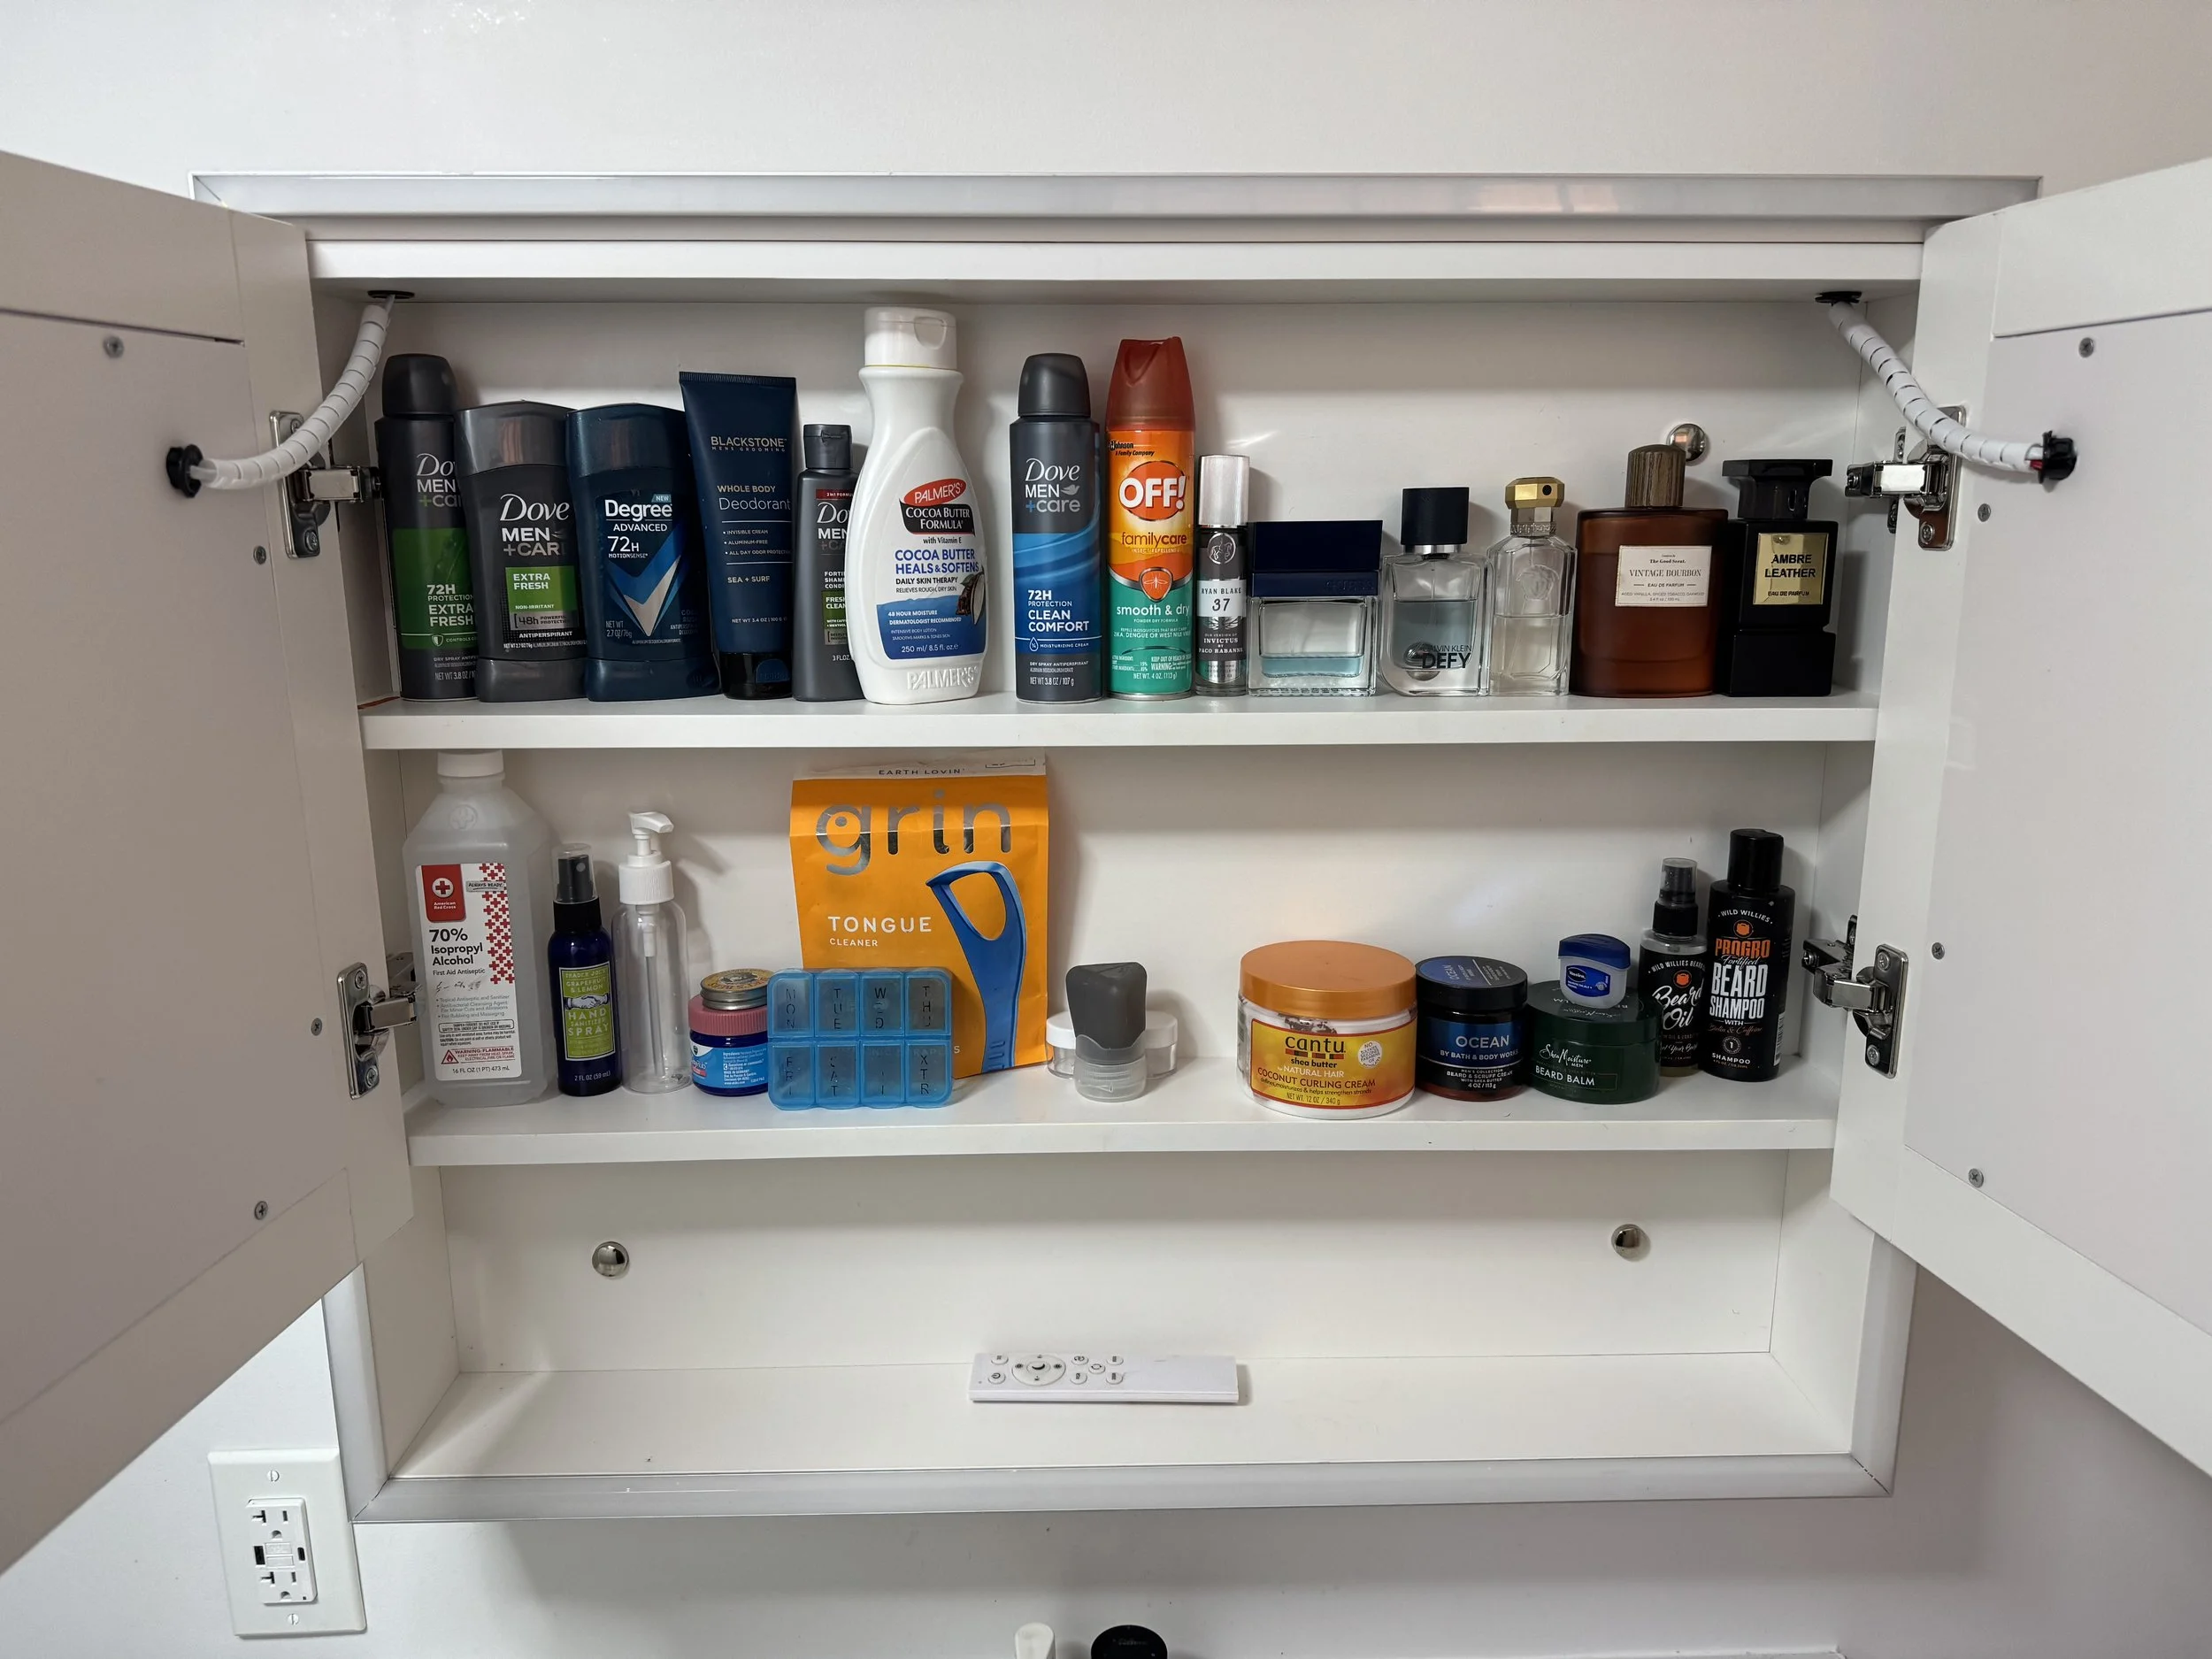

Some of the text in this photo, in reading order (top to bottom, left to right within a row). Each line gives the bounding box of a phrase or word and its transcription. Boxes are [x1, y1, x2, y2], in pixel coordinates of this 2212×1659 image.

[710, 435, 785, 448] BLACKSTONE
[416, 453, 456, 477] Do
[1025, 457, 1080, 481] Dove
[417, 479, 456, 494] MEN
[914, 481, 962, 504] PALMER'S
[1025, 484, 1060, 498] MEN
[1118, 475, 1187, 511] OFF!
[500, 493, 570, 521] Dove
[604, 499, 672, 522] Degree
[718, 497, 791, 511] Deodorant
[1025, 499, 1081, 512] +care
[817, 501, 850, 524] Do
[905, 507, 970, 518] COCOA BUTTER
[613, 523, 668, 532] ADVANCED
[920, 518, 962, 530] FORMULA
[502, 527, 550, 542] MEN
[818, 527, 848, 540] MEN
[1121, 532, 1187, 548] familycare
[503, 542, 564, 557] +CAR
[607, 535, 640, 552] 72H
[895, 549, 975, 561] COCOA BUTTER
[1771, 554, 1813, 564] AMBRE
[895, 563, 933, 574] HEALS
[941, 562, 979, 573] SOFTENS
[1764, 568, 1816, 578] LEATHER
[426, 584, 456, 595] 72H
[513, 581, 549, 590] FRESH
[1028, 589, 1052, 601] 72H
[428, 603, 474, 616] EXTRA
[1117, 603, 1190, 617] smooth & dry
[1212, 598, 1231, 612] 37
[429, 616, 473, 627] FRESH
[518, 616, 539, 625] 48h
[1028, 610, 1071, 620] CLEAN
[1028, 620, 1089, 633] COMFORT
[1422, 652, 1471, 669] DEFY
[907, 667, 974, 690] PALMER'S
[816, 787, 1012, 877] grin
[1740, 910, 1770, 923] WILLIES
[827, 916, 933, 933] TONGUE
[429, 927, 469, 942] 70%
[431, 941, 483, 956] Isopropyl
[829, 937, 879, 947] CLEANER
[1715, 938, 1771, 959] PROGRO
[433, 954, 474, 966] Alcohol
[1720, 954, 1759, 971] Fortified
[457, 967, 486, 976] Antiseptic
[1710, 961, 1769, 998] BEARD
[577, 984, 603, 993] LEMON
[1652, 978, 1705, 1010] Beard
[568, 1007, 607, 1020] HAND
[1709, 995, 1765, 1020] SHAMPOO
[1663, 1007, 1694, 1031] Oil
[568, 1023, 609, 1036] SPRAY
[1285, 1036, 1345, 1054] cantu
[1455, 1034, 1509, 1048] OCEAN
[1291, 1056, 1338, 1069] shea butter
[1711, 1052, 1751, 1064] SHAMPOO
[1257, 1067, 1376, 1089] COCONUT CURLING CREAM
[1535, 1065, 1563, 1081] BEARD
[1567, 1074, 1595, 1087] BALM
